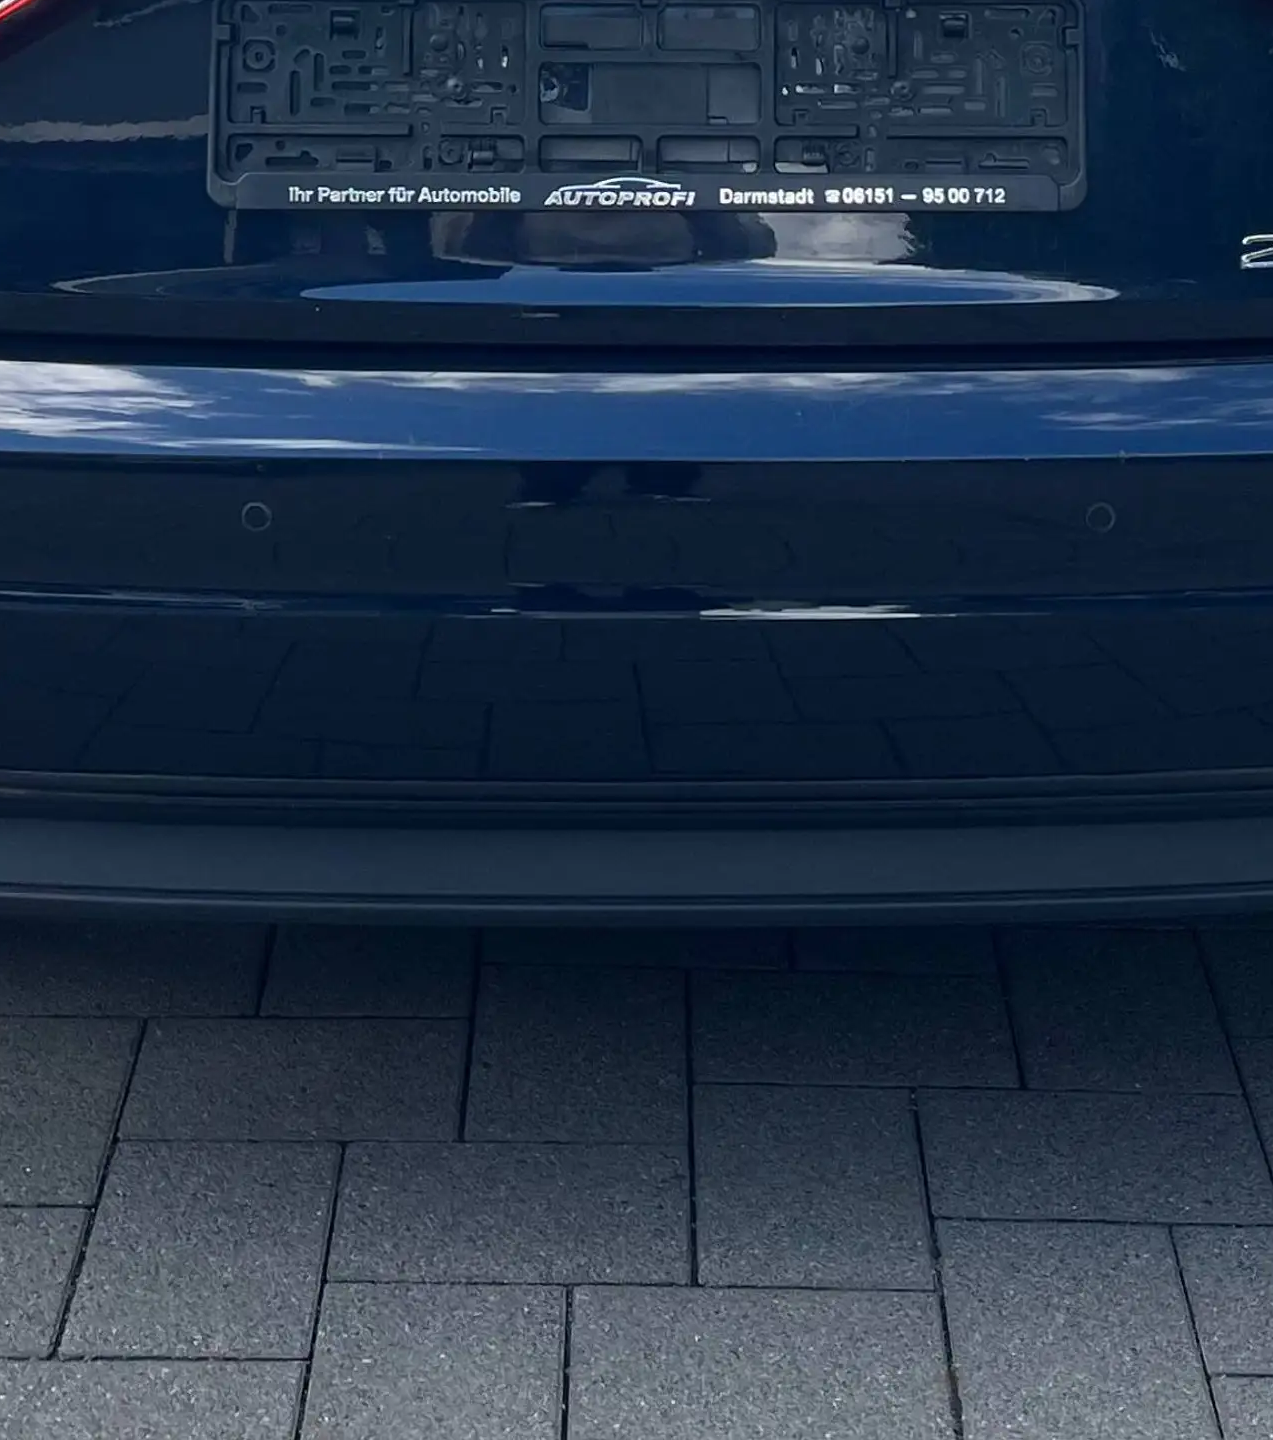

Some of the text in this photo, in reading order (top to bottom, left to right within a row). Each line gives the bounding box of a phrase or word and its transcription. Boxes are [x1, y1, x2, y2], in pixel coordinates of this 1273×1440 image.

[288, 185, 522, 204] Ihr Partner für Automobile
[543, 189, 697, 206] AUTOPROFI
[718, 187, 815, 205] Darmstadt
[842, 187, 895, 205] 06151
[975, 187, 1007, 205] 712
